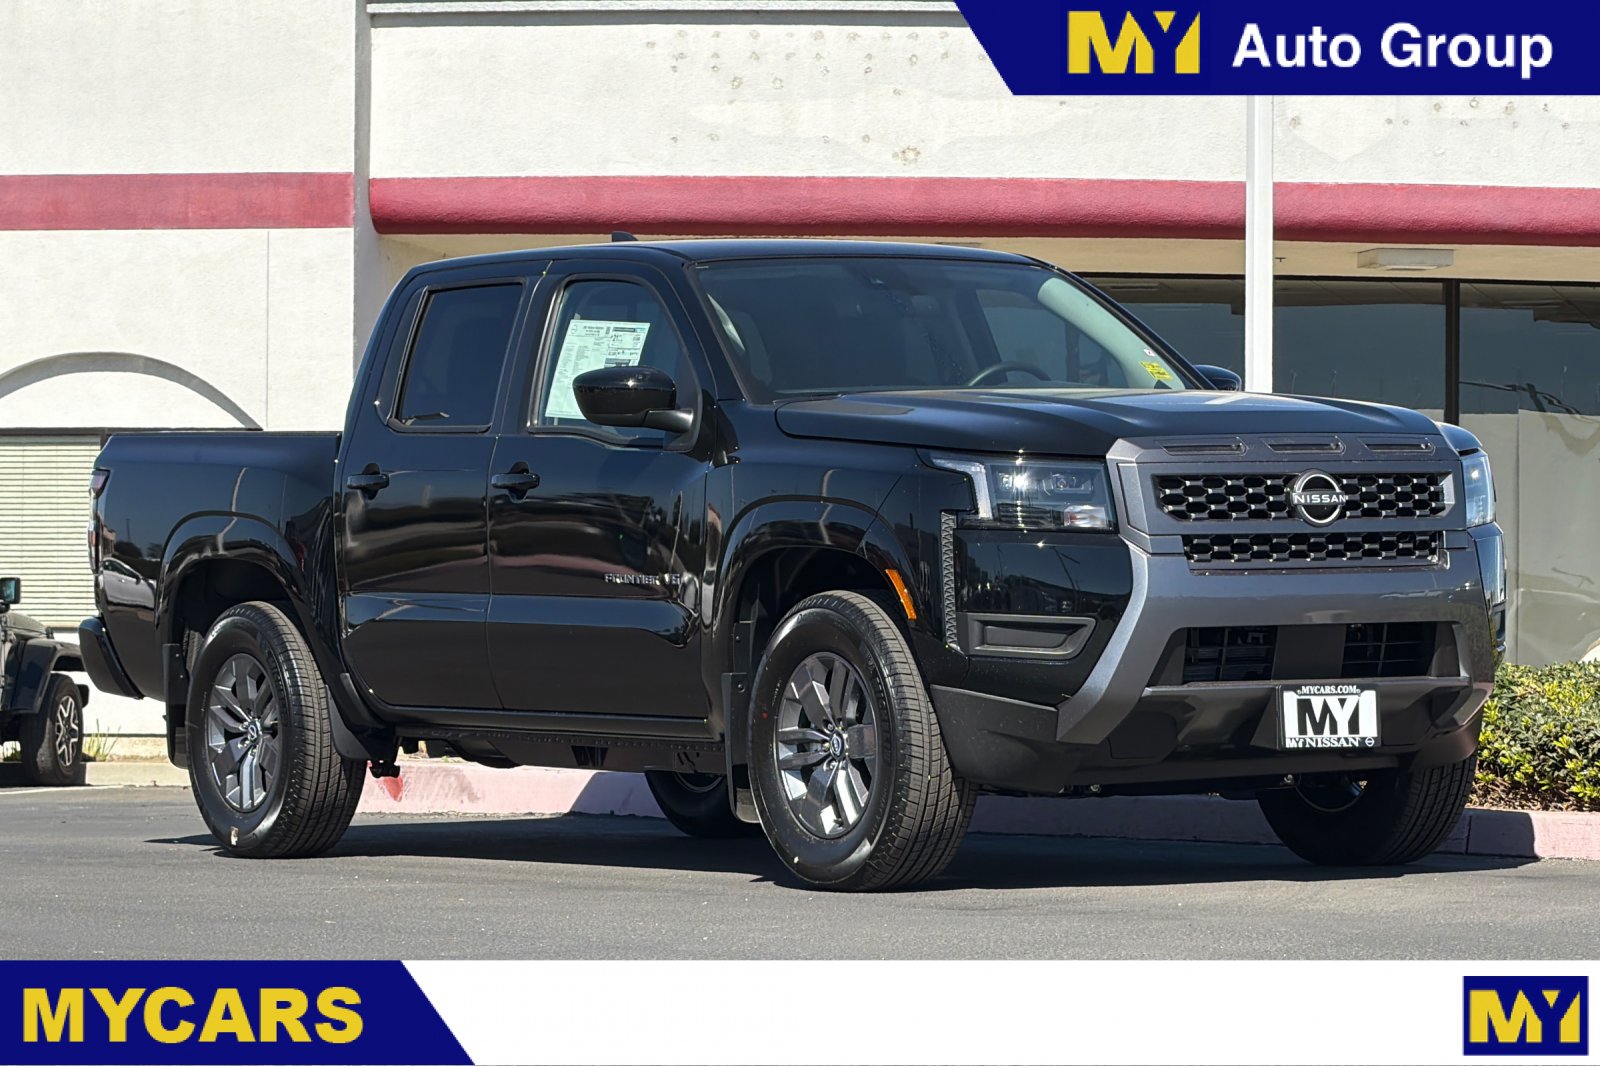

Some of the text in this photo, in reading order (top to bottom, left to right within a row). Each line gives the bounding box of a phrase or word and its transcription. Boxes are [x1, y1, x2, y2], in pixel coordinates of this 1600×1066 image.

[1293, 494, 1346, 504] NISSAN
[604, 573, 660, 586] FRONTIER
[1300, 685, 1357, 695] MYCARS.COM
[1296, 697, 1360, 737] MY
[1305, 737, 1360, 748] NISSAN
